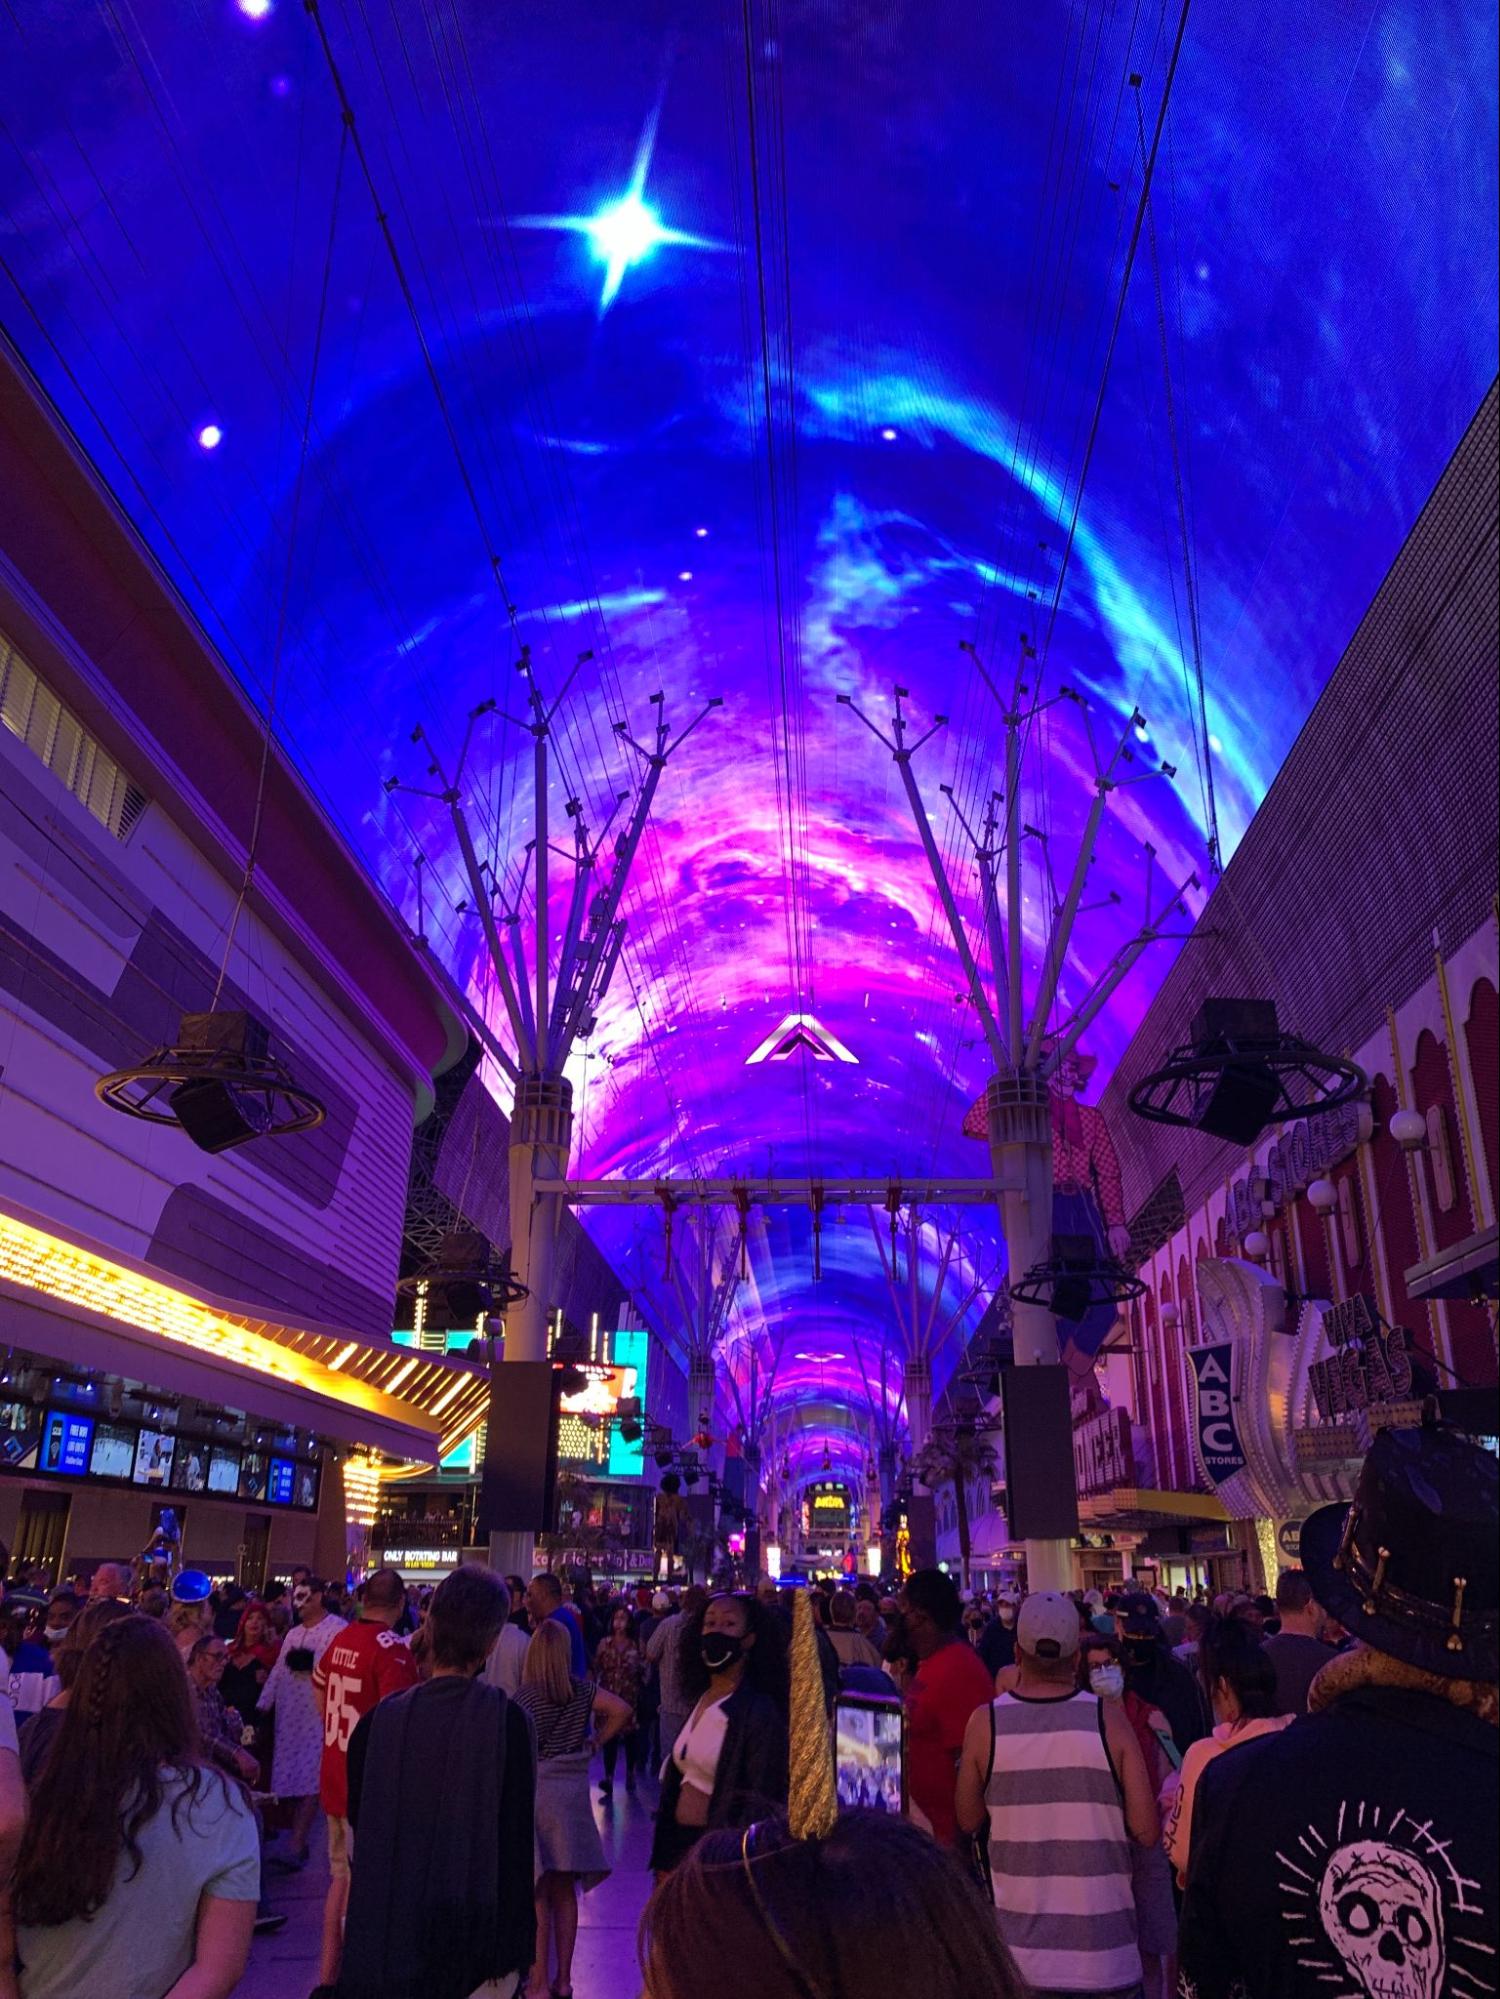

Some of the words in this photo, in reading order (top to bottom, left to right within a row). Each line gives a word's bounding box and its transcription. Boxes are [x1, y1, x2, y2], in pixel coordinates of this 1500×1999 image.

[1307, 1326, 1412, 1420] VEGAS
[1198, 1352, 1234, 1452] ABC
[1204, 1456, 1245, 1465] STORES
[383, 1550, 404, 1562] ONLY
[404, 1550, 440, 1562] ROTATING
[441, 1550, 458, 1563] BAR
[1281, 1530, 1300, 1542] AB
[325, 1671, 362, 1753] 85
